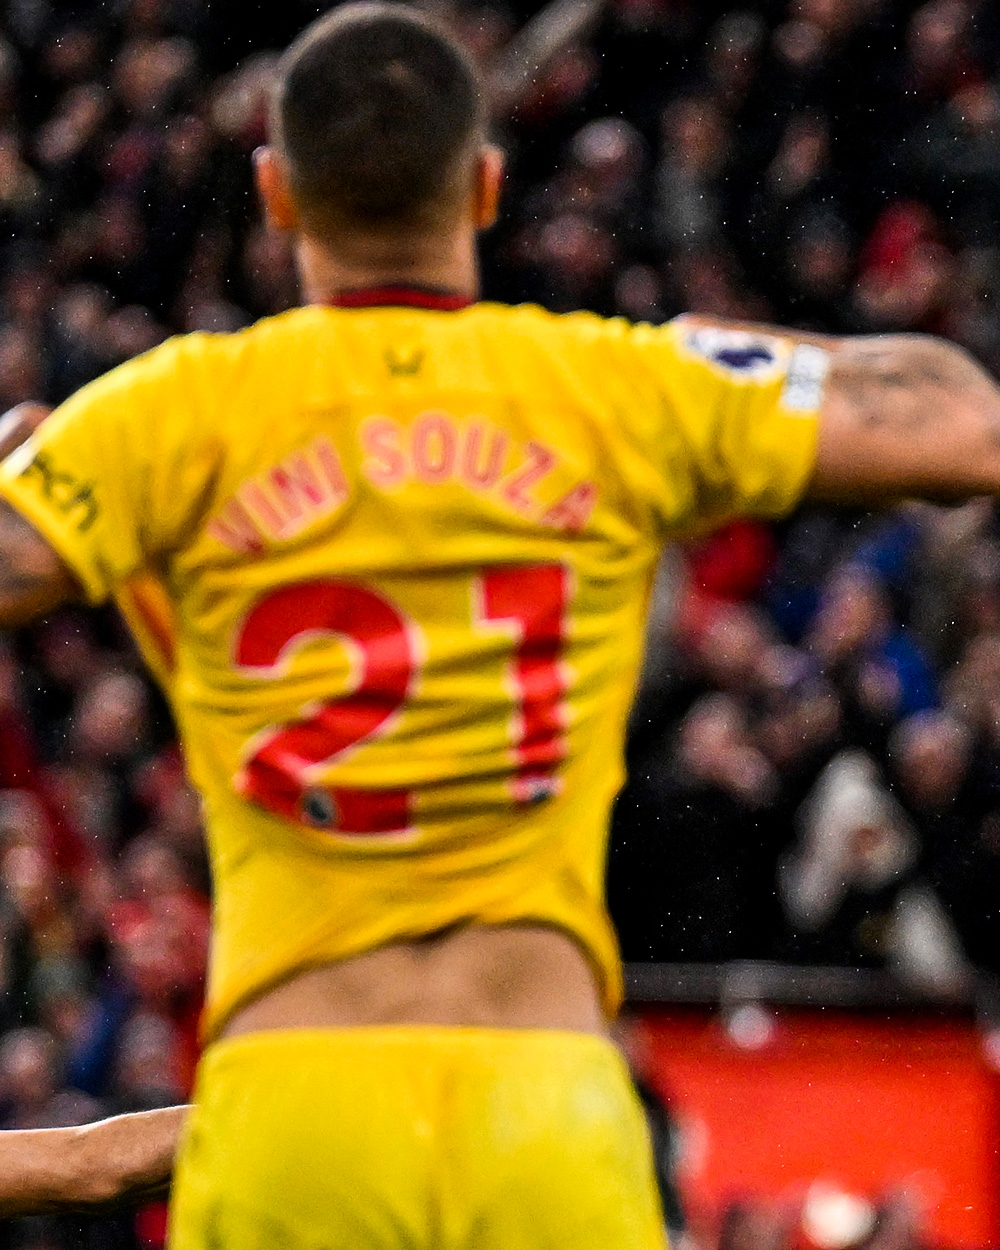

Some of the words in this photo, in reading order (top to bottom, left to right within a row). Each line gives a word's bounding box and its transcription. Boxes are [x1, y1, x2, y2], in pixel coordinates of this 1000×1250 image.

[206, 434, 350, 557] VINI
[358, 410, 598, 538] SOUZA
[232, 560, 573, 844] 21
